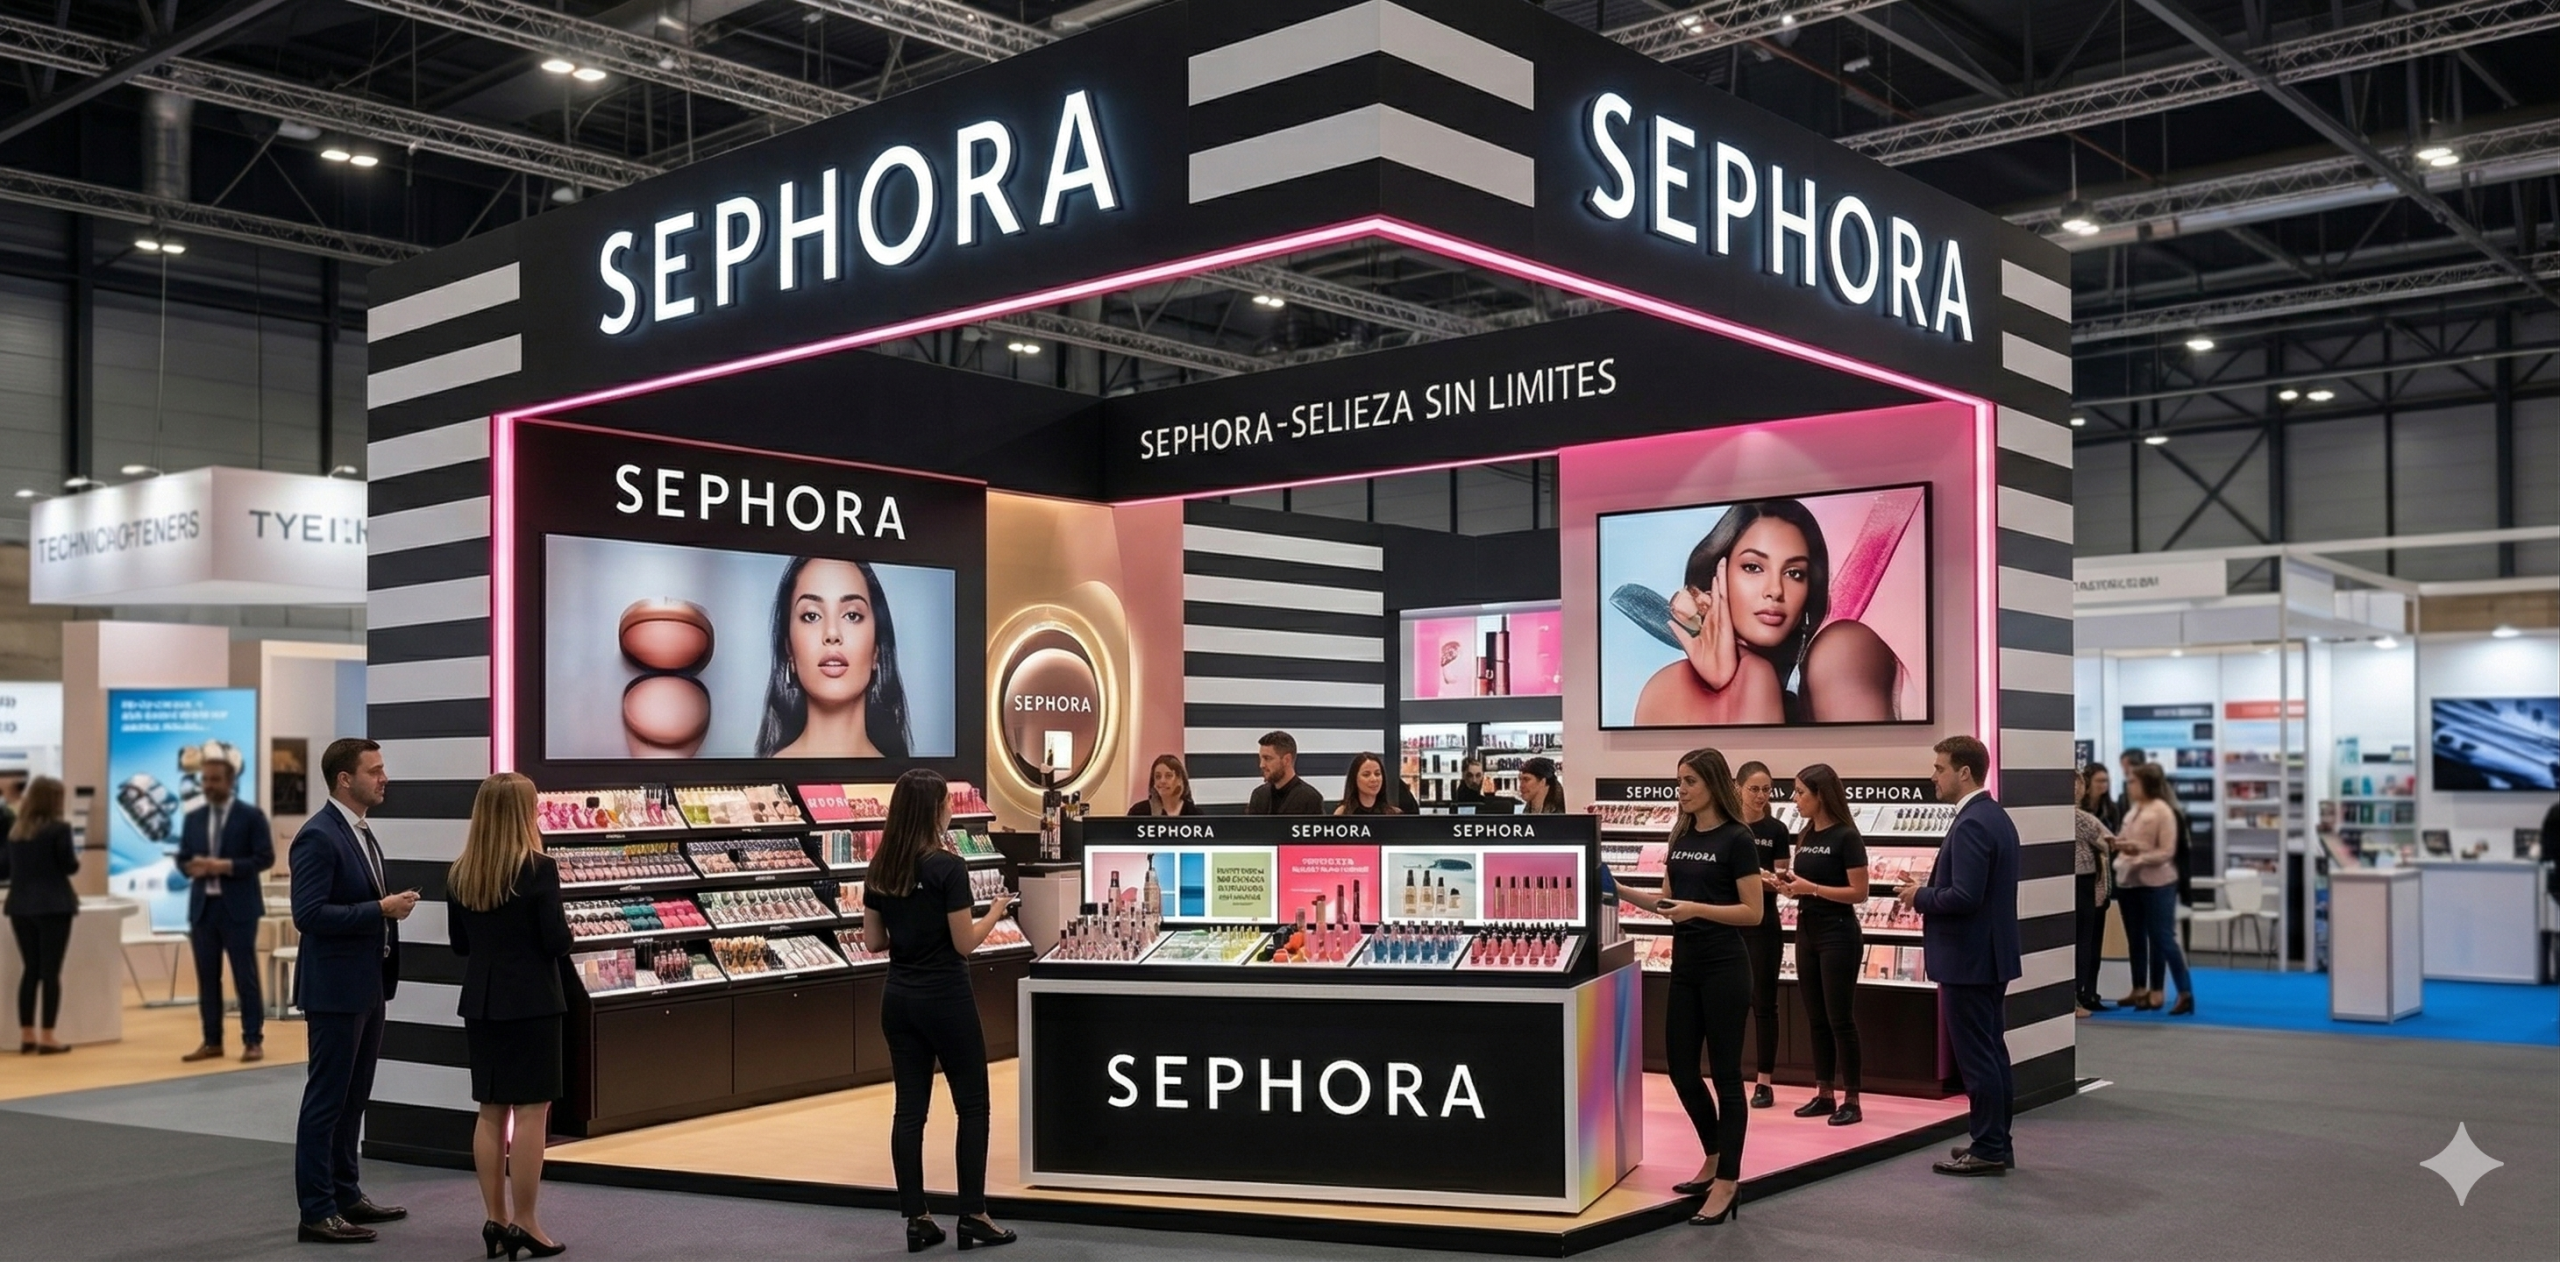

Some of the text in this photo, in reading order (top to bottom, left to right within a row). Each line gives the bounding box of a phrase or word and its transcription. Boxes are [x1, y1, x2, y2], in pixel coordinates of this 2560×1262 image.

[600, 89, 1118, 336] SEPHORA
[1590, 92, 1973, 342] SEPHORA
[1425, 379, 1477, 419] SIN
[1489, 358, 1617, 410] LIMITES
[616, 464, 906, 540] SEPHORA
[1014, 695, 1091, 712] SEPHORA
[1626, 786, 1680, 798] SEPHOR
[1845, 787, 1923, 800] SEPHORA
[1137, 825, 1214, 838] SEPHORA
[1292, 825, 1371, 837] SEPHORA
[1453, 824, 1535, 837] SEPHORA
[1107, 1053, 1486, 1119] SEPHORA
